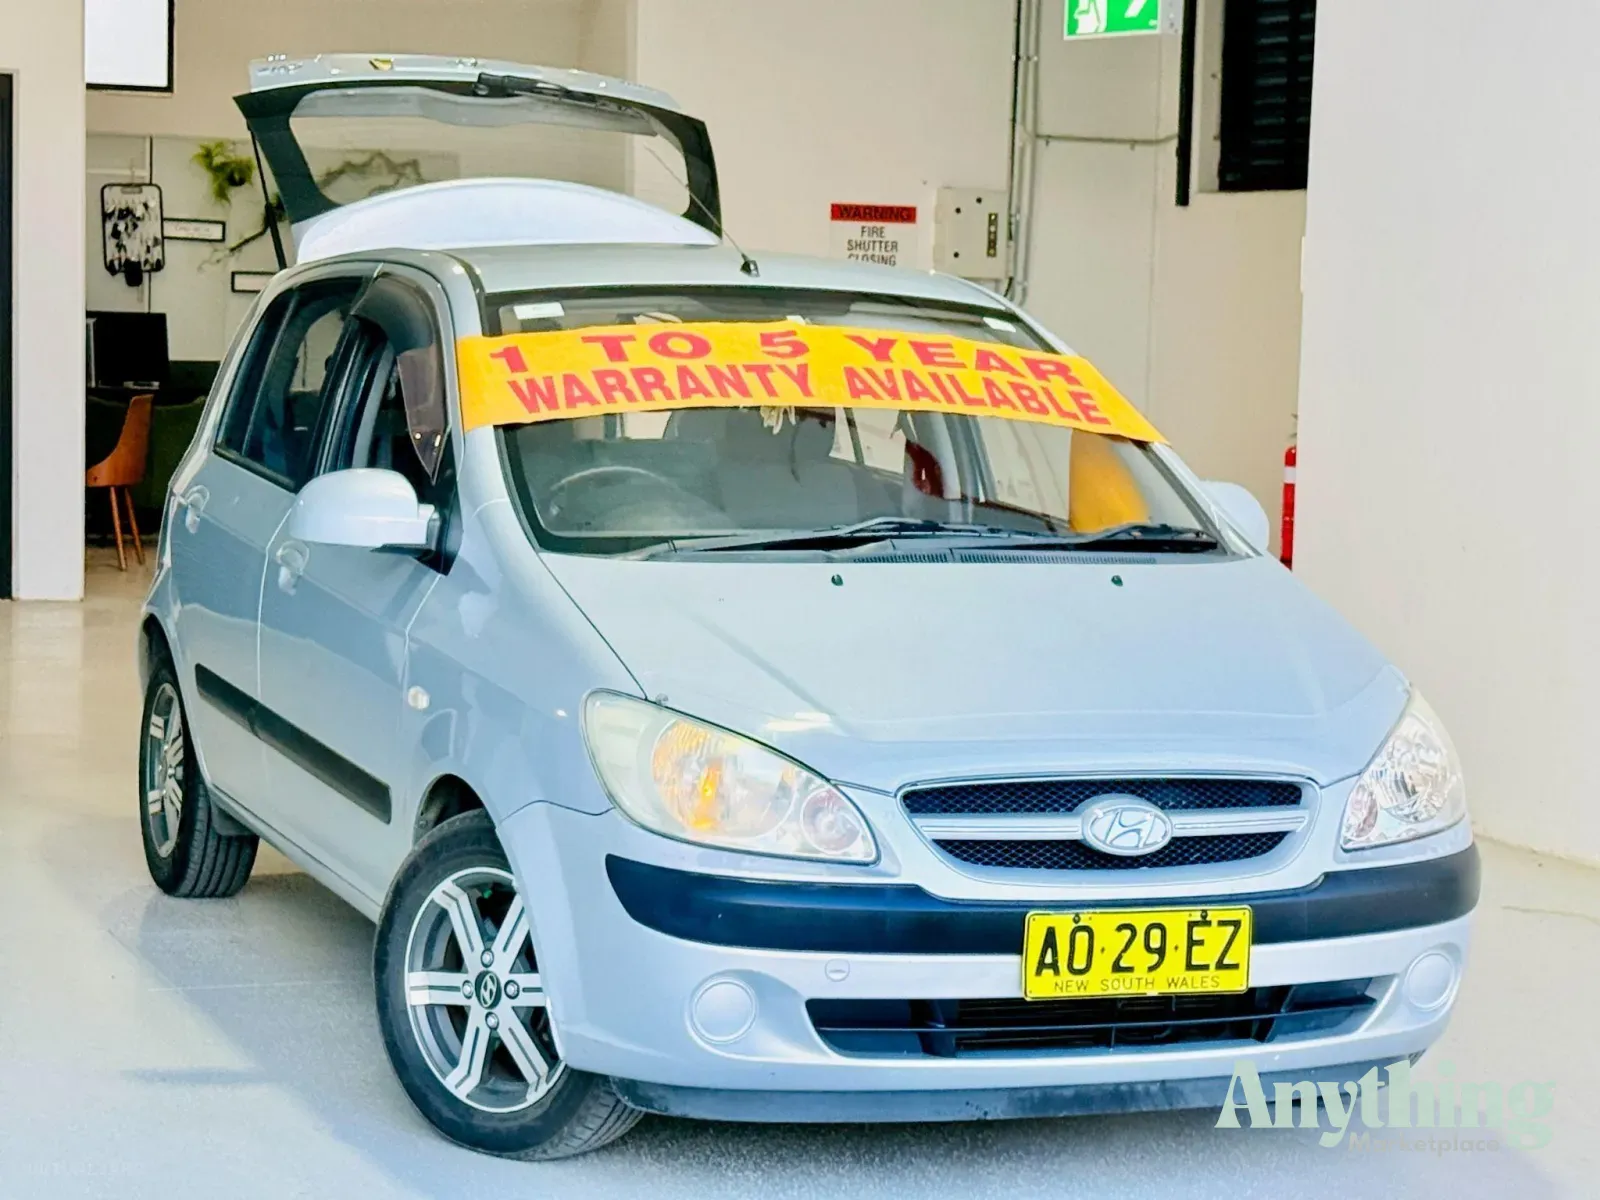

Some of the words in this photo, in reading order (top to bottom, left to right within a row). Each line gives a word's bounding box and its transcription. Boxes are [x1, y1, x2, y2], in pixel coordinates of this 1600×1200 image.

[839, 204, 911, 222] WARNING
[860, 225, 886, 239] FIRE
[846, 239, 898, 253] SHUTTER
[489, 345, 530, 374] 1
[581, 331, 713, 363] TO
[759, 330, 811, 359] 5
[844, 334, 1085, 386] YEAR
[507, 363, 815, 415] WARRANTY
[843, 365, 1112, 426] AVAILABLE
[1110, 922, 1168, 973] 29
[1184, 919, 1243, 972] EZ
[1053, 979, 1090, 993] NEW
[1100, 978, 1155, 992] SOUTH
[1166, 975, 1221, 989] WALES
